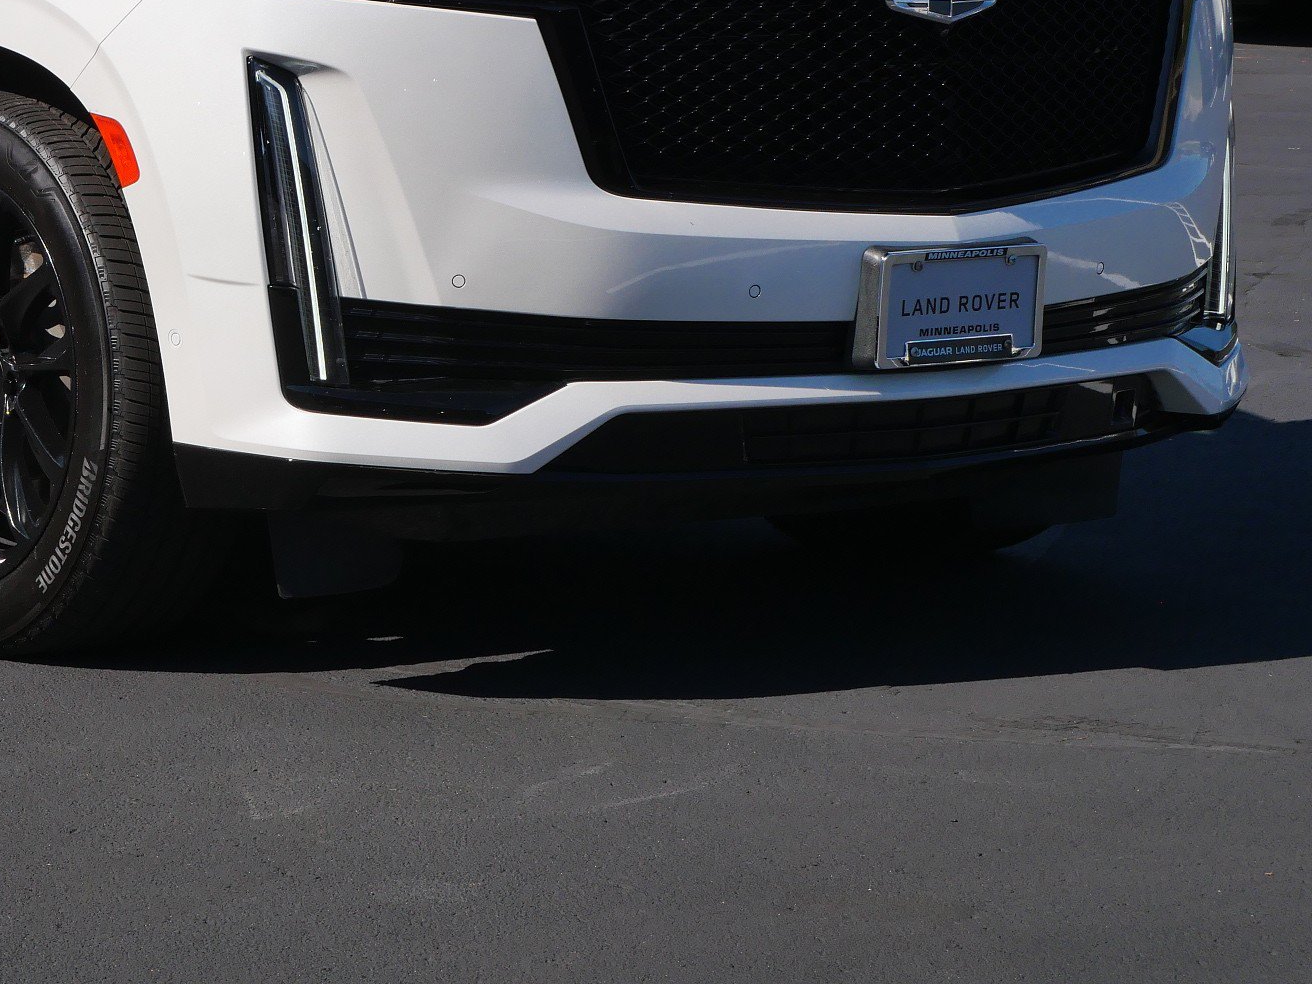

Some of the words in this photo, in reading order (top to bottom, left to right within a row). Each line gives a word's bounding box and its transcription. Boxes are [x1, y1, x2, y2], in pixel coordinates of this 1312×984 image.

[928, 248, 1005, 260] MINNEAPOLIS
[901, 295, 950, 316] LAND
[958, 291, 1020, 313] ROVER
[919, 323, 1000, 337] MINNEAPOLIS
[917, 346, 953, 357] JAGUAR
[955, 345, 976, 355] LAND
[978, 343, 1003, 353] ROVER
[35, 457, 99, 594] BRIDGESTONE
